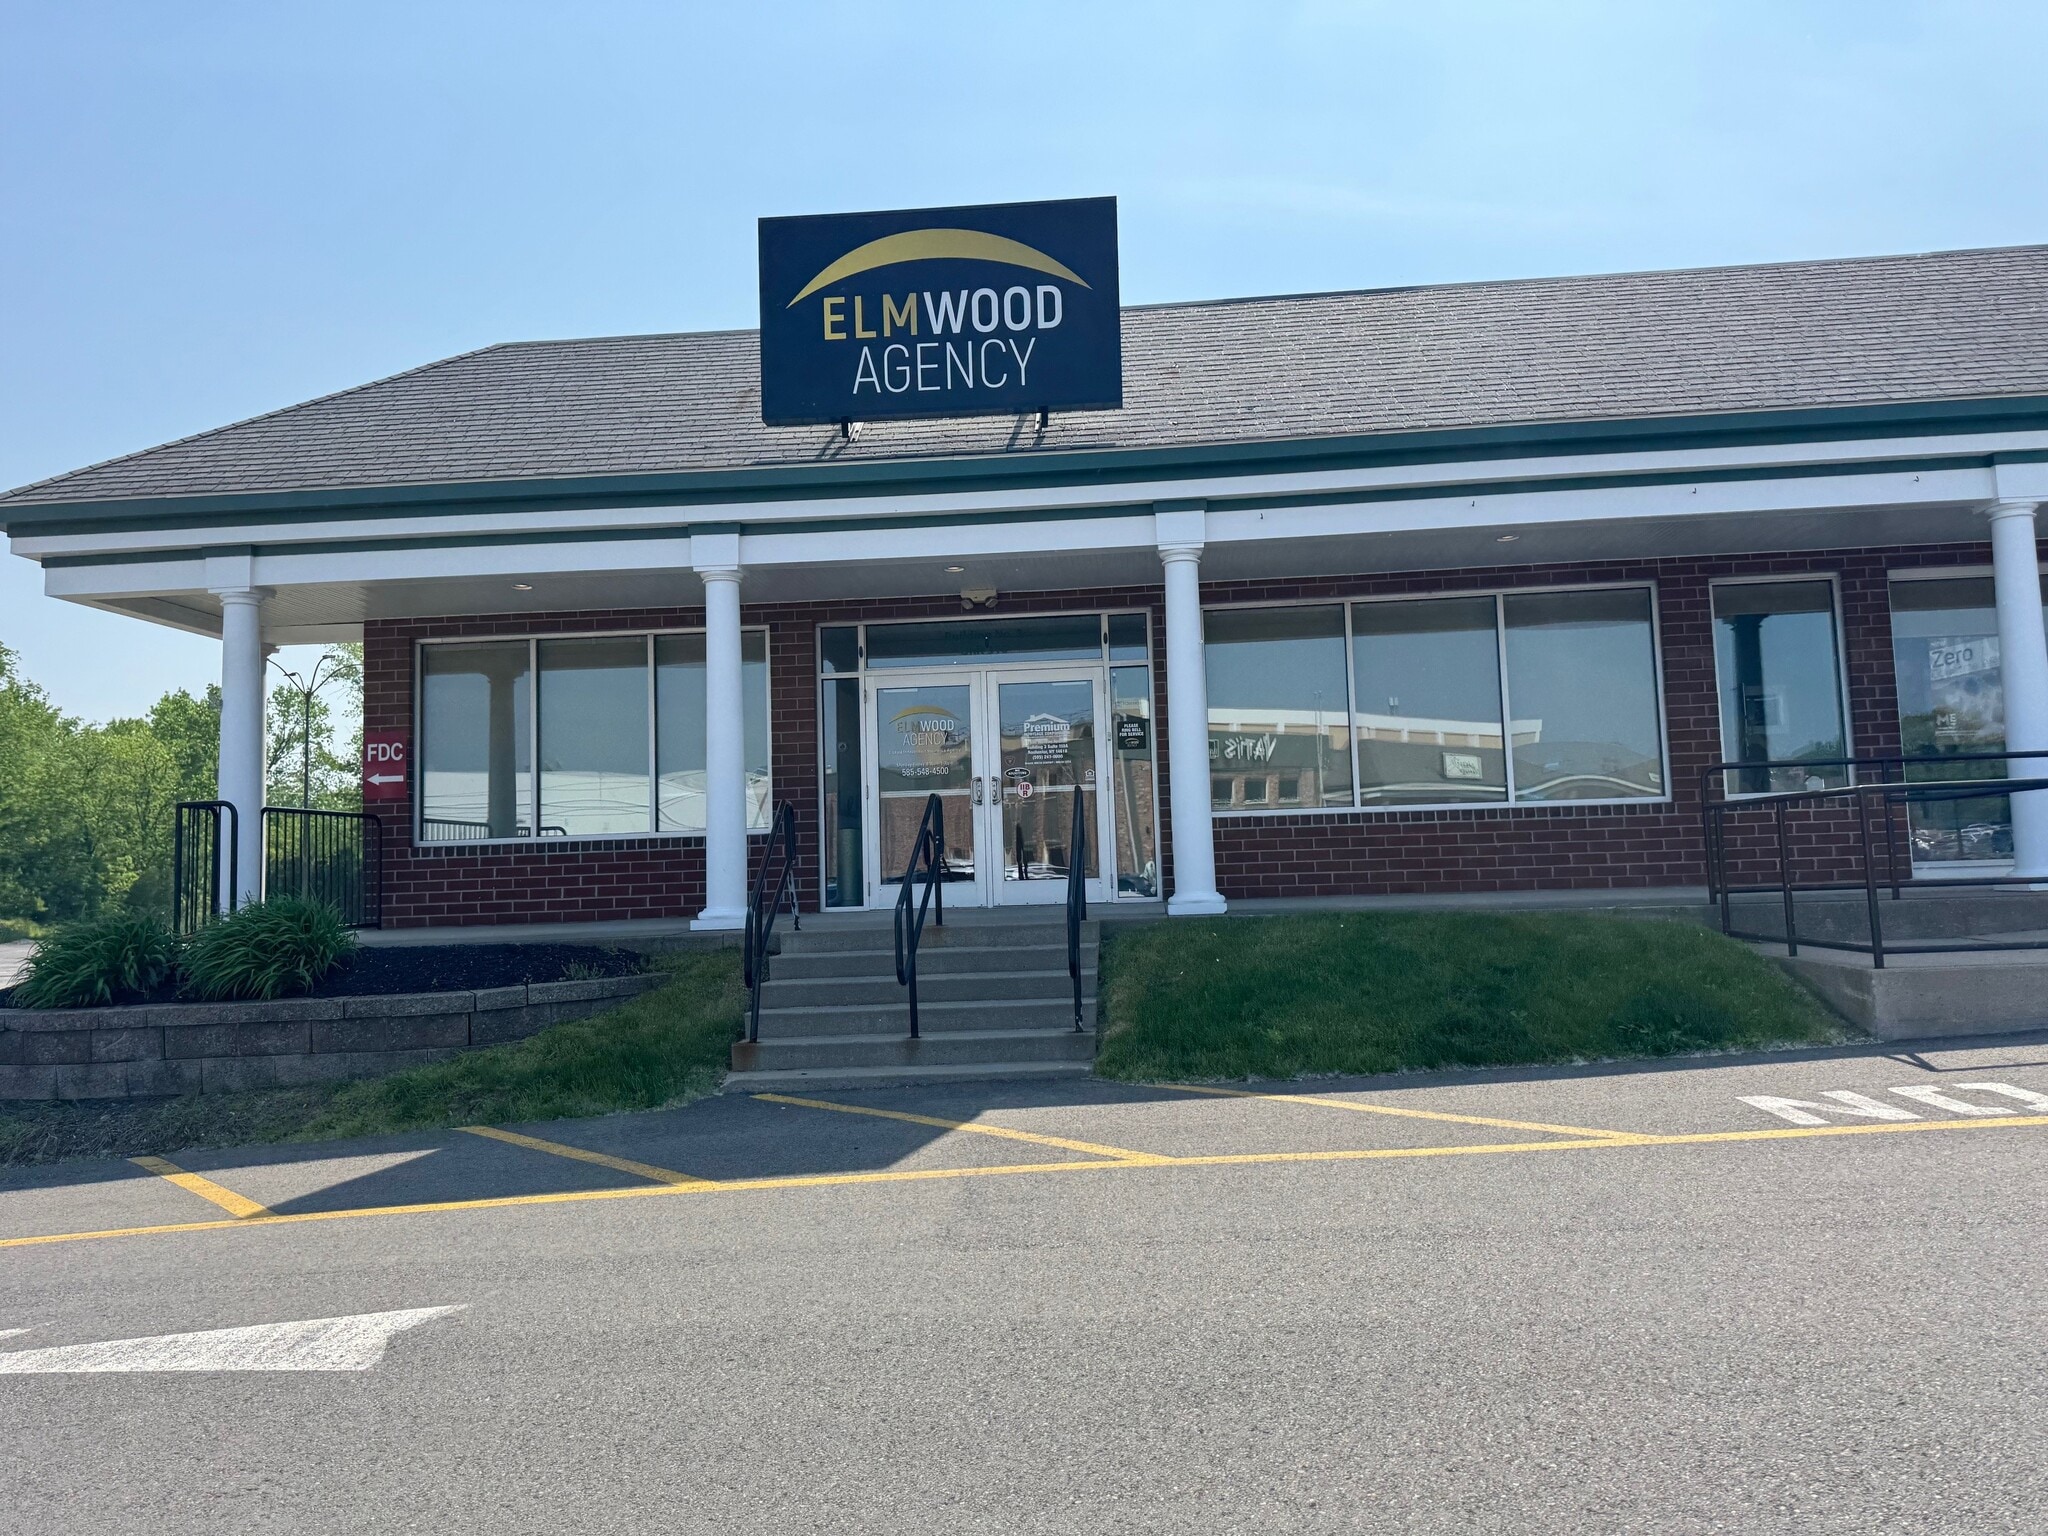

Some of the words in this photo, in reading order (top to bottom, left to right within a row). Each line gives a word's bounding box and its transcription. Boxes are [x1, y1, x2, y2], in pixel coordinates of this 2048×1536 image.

[823, 285, 1063, 341] ELMWOOD
[852, 337, 1036, 395] AGENCY
[1931, 648, 1973, 668] Zero
[897, 719, 955, 733] ELMWOOD
[1023, 721, 1071, 732] Premium
[902, 731, 948, 746] AGENCY
[367, 742, 403, 762] FDC
[901, 766, 949, 777] 585-548-4500
